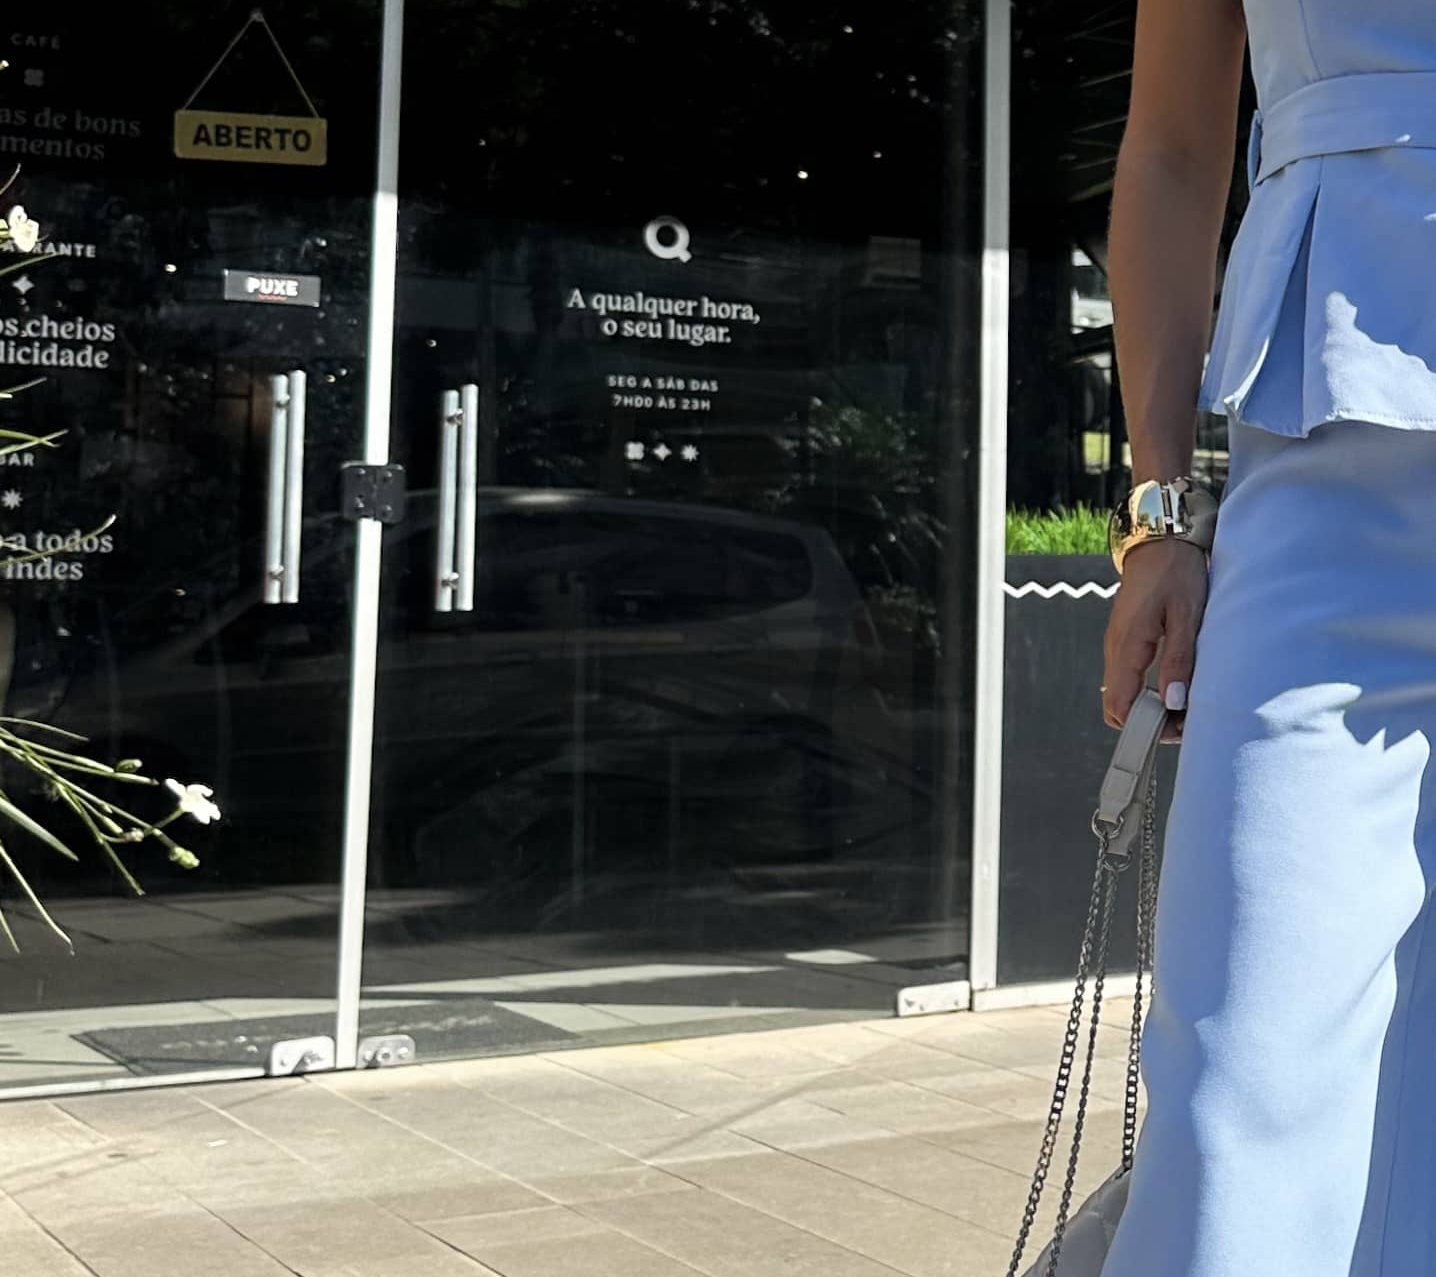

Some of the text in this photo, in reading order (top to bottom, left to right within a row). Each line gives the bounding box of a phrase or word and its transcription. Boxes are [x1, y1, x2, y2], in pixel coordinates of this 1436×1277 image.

[33, 107, 67, 131] de
[74, 108, 143, 138] bons
[192, 124, 312, 153] ABERTO
[643, 214, 692, 263] Q
[246, 277, 299, 297] PUXE
[568, 288, 760, 324] A qualquer hora,
[25, 315, 117, 343] cheios
[602, 319, 732, 346] o seu lugar.
[607, 374, 638, 389] SEG
[642, 377, 653, 389] A
[690, 378, 719, 393] DAS
[611, 393, 654, 409] 7H00
[681, 398, 711, 412] 23H
[35, 528, 115, 554] todos
